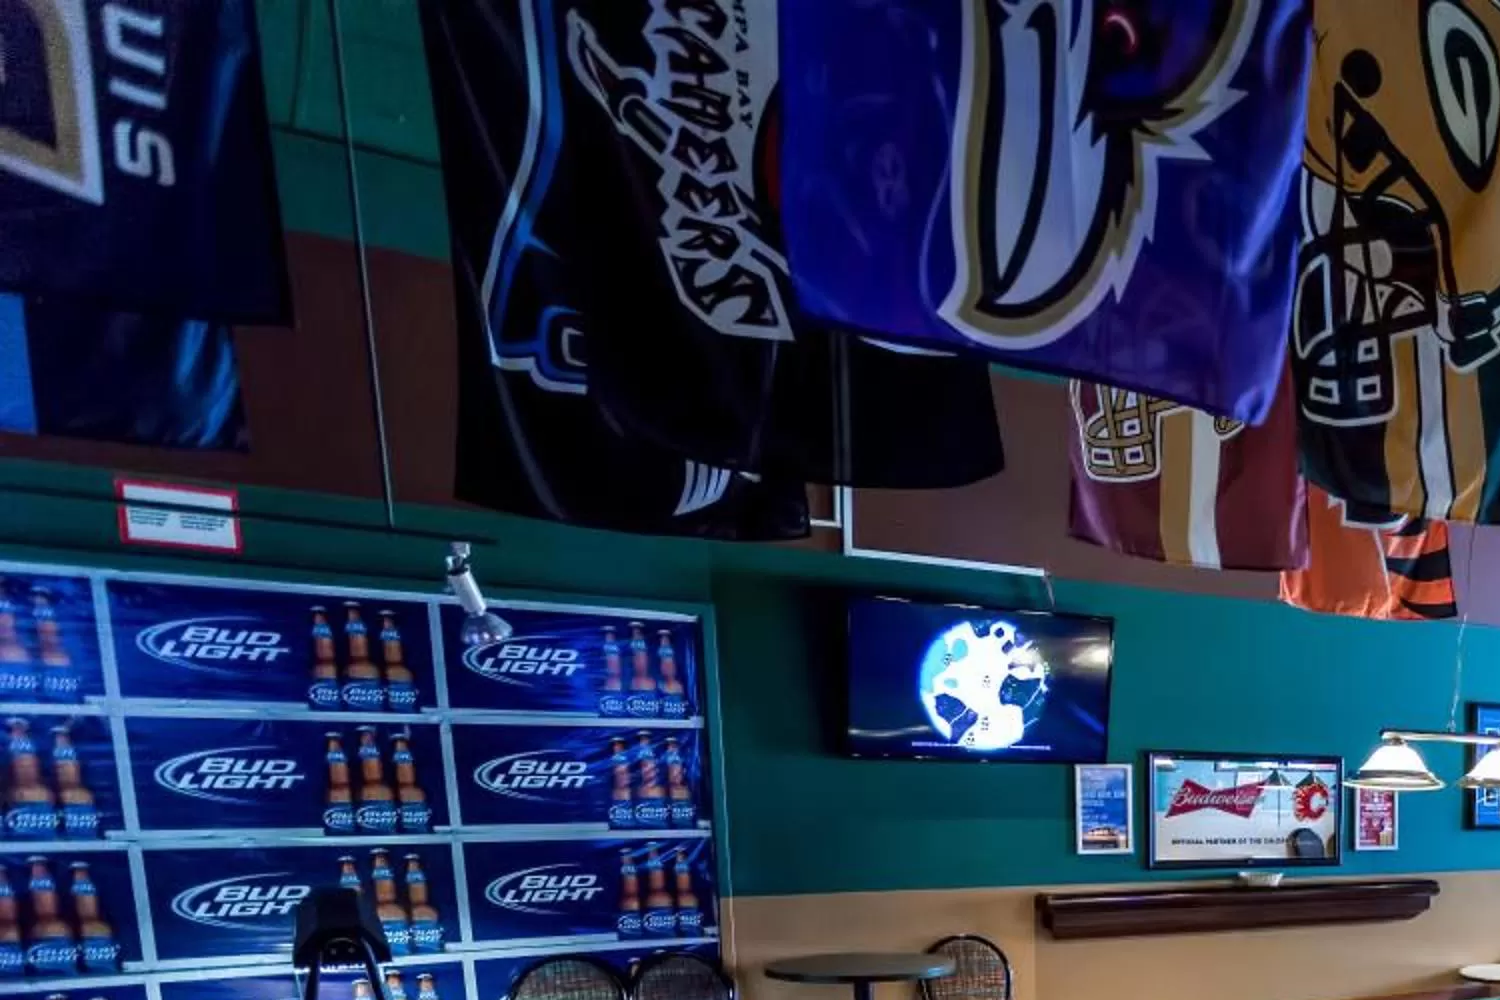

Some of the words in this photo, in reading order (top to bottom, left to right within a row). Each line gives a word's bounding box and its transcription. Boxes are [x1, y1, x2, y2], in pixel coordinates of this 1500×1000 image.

[735, 70, 753, 130] BAY
[181, 627, 281, 646] BUD
[160, 640, 290, 662] LIGHT
[498, 645, 580, 663] BUD
[481, 657, 586, 677] LIGHT
[198, 757, 297, 774] BUD
[508, 759, 588, 776] BUD
[177, 770, 305, 790] LIGHT
[493, 773, 596, 789] LIGHT
[520, 874, 597, 890] BUD
[213, 885, 311, 903] BUD
[503, 886, 603, 904] LIGHT
